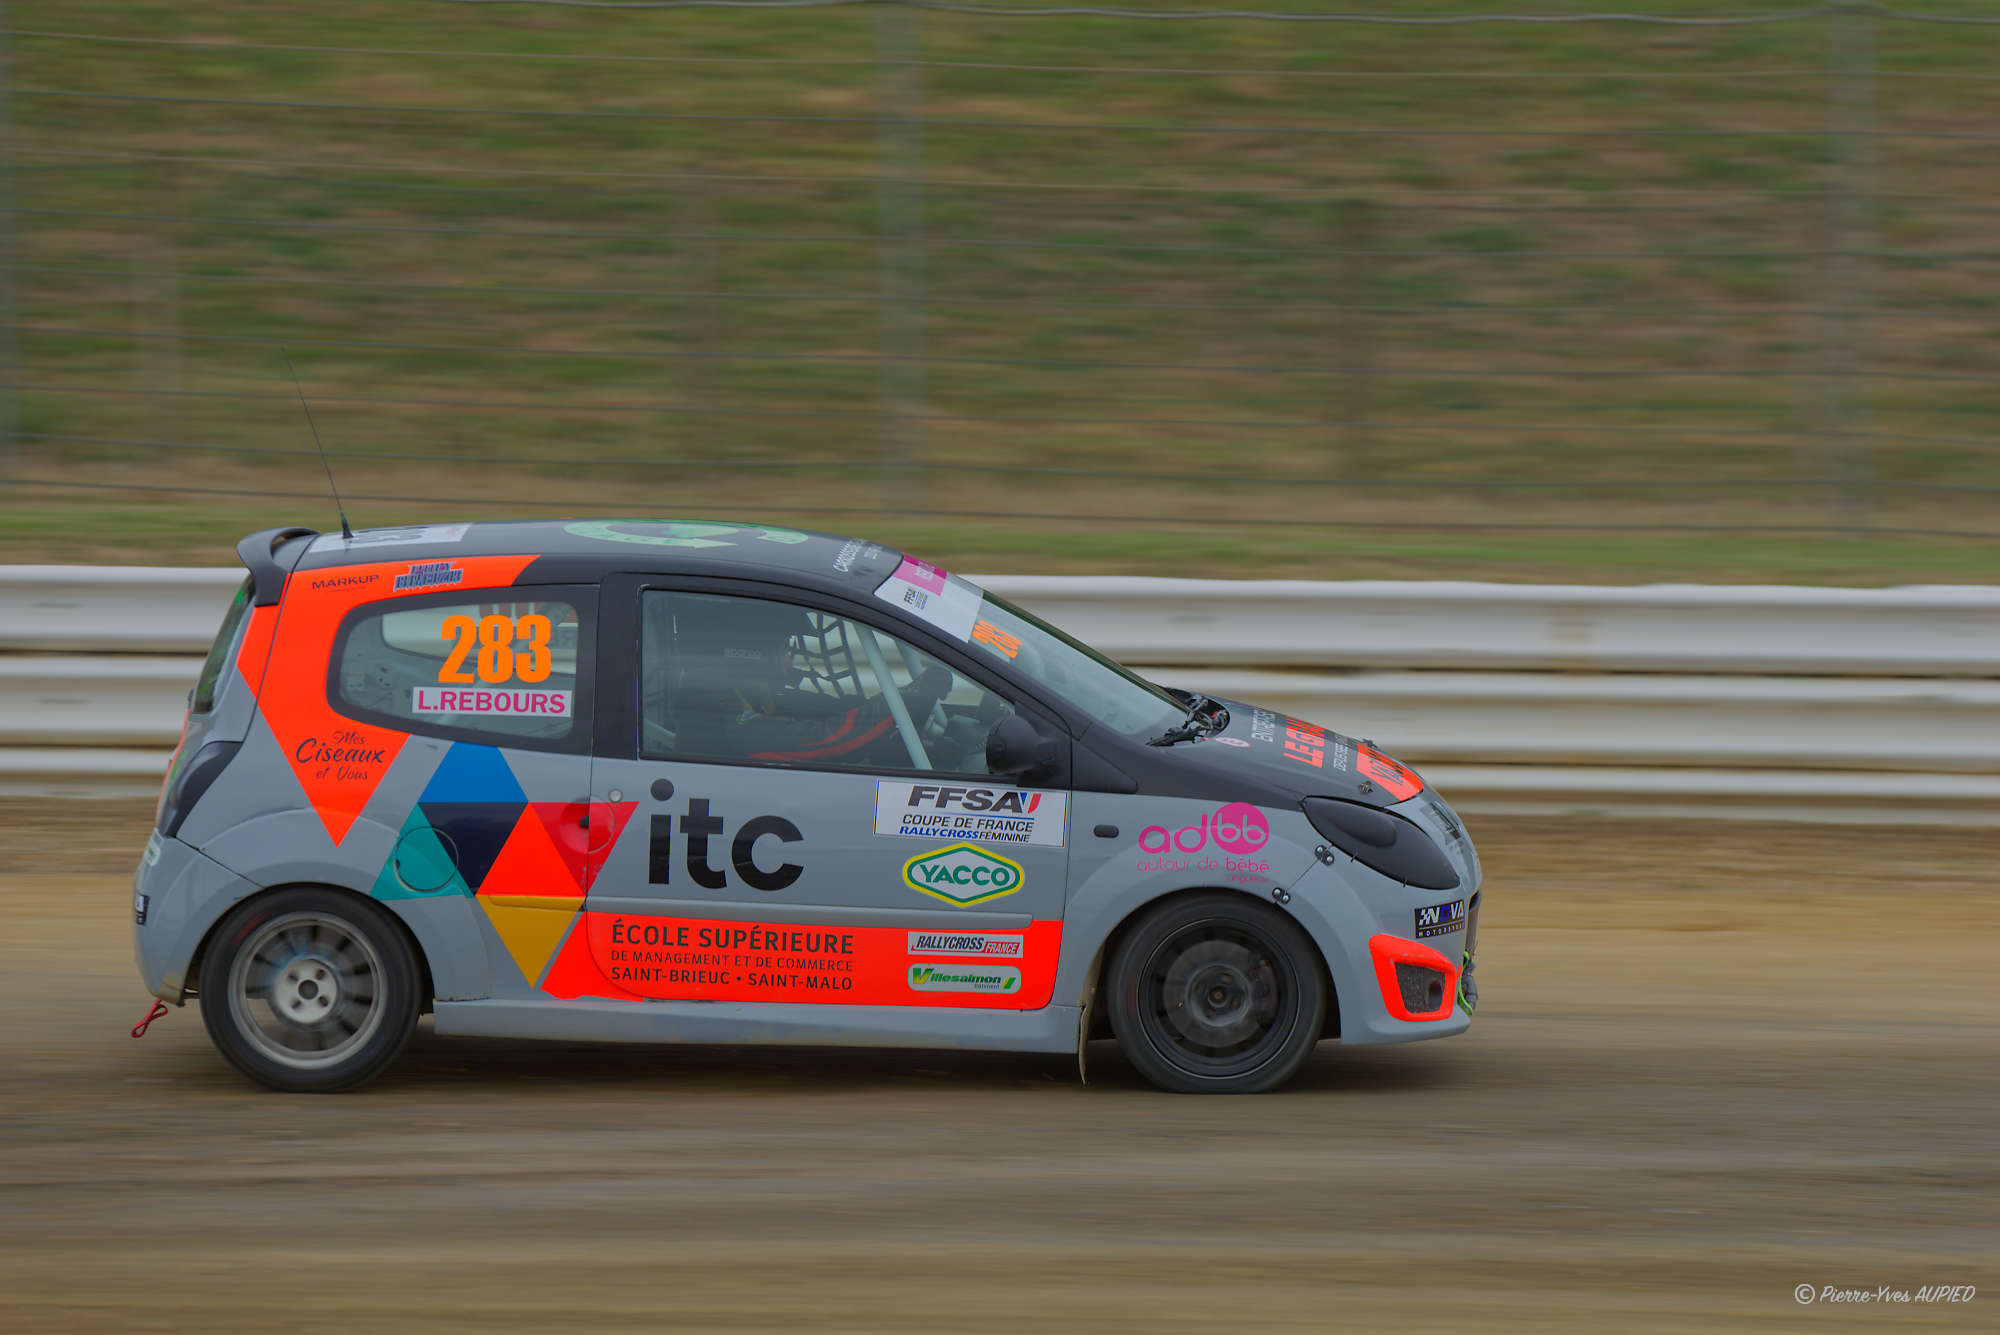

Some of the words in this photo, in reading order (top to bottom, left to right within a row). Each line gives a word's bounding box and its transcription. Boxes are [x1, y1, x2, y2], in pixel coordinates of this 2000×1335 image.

[312, 574, 380, 589] MARKUP
[438, 614, 552, 684] 283
[418, 690, 565, 714] L.REBOURS
[333, 731, 365, 744] Mes
[296, 738, 386, 763] Ciseaux
[316, 766, 330, 780] et
[337, 766, 368, 781] Vous
[907, 785, 1024, 814] FFSA
[649, 778, 804, 891] itc
[902, 813, 951, 827] COUPE
[953, 817, 974, 829] DE
[976, 819, 1034, 833] FRANCE
[919, 864, 1011, 887] YACCO
[1136, 856, 1192, 872] autour
[1197, 856, 1219, 871] de
[1226, 856, 1270, 874] bébé
[612, 918, 690, 947] ÉCOLE
[699, 925, 854, 954] SUPÉRIEURE
[916, 935, 985, 951] RALLYCROSS
[985, 942, 1018, 954] FRANCE
[611, 950, 628, 961] DE
[632, 951, 730, 967] MANAGEMENT
[734, 955, 751, 967] ET
[755, 956, 772, 968] DE
[777, 957, 853, 972] COMMERCE
[611, 967, 730, 985] SAINT-BRIEUC
[748, 972, 852, 990] SAINT-MALO
